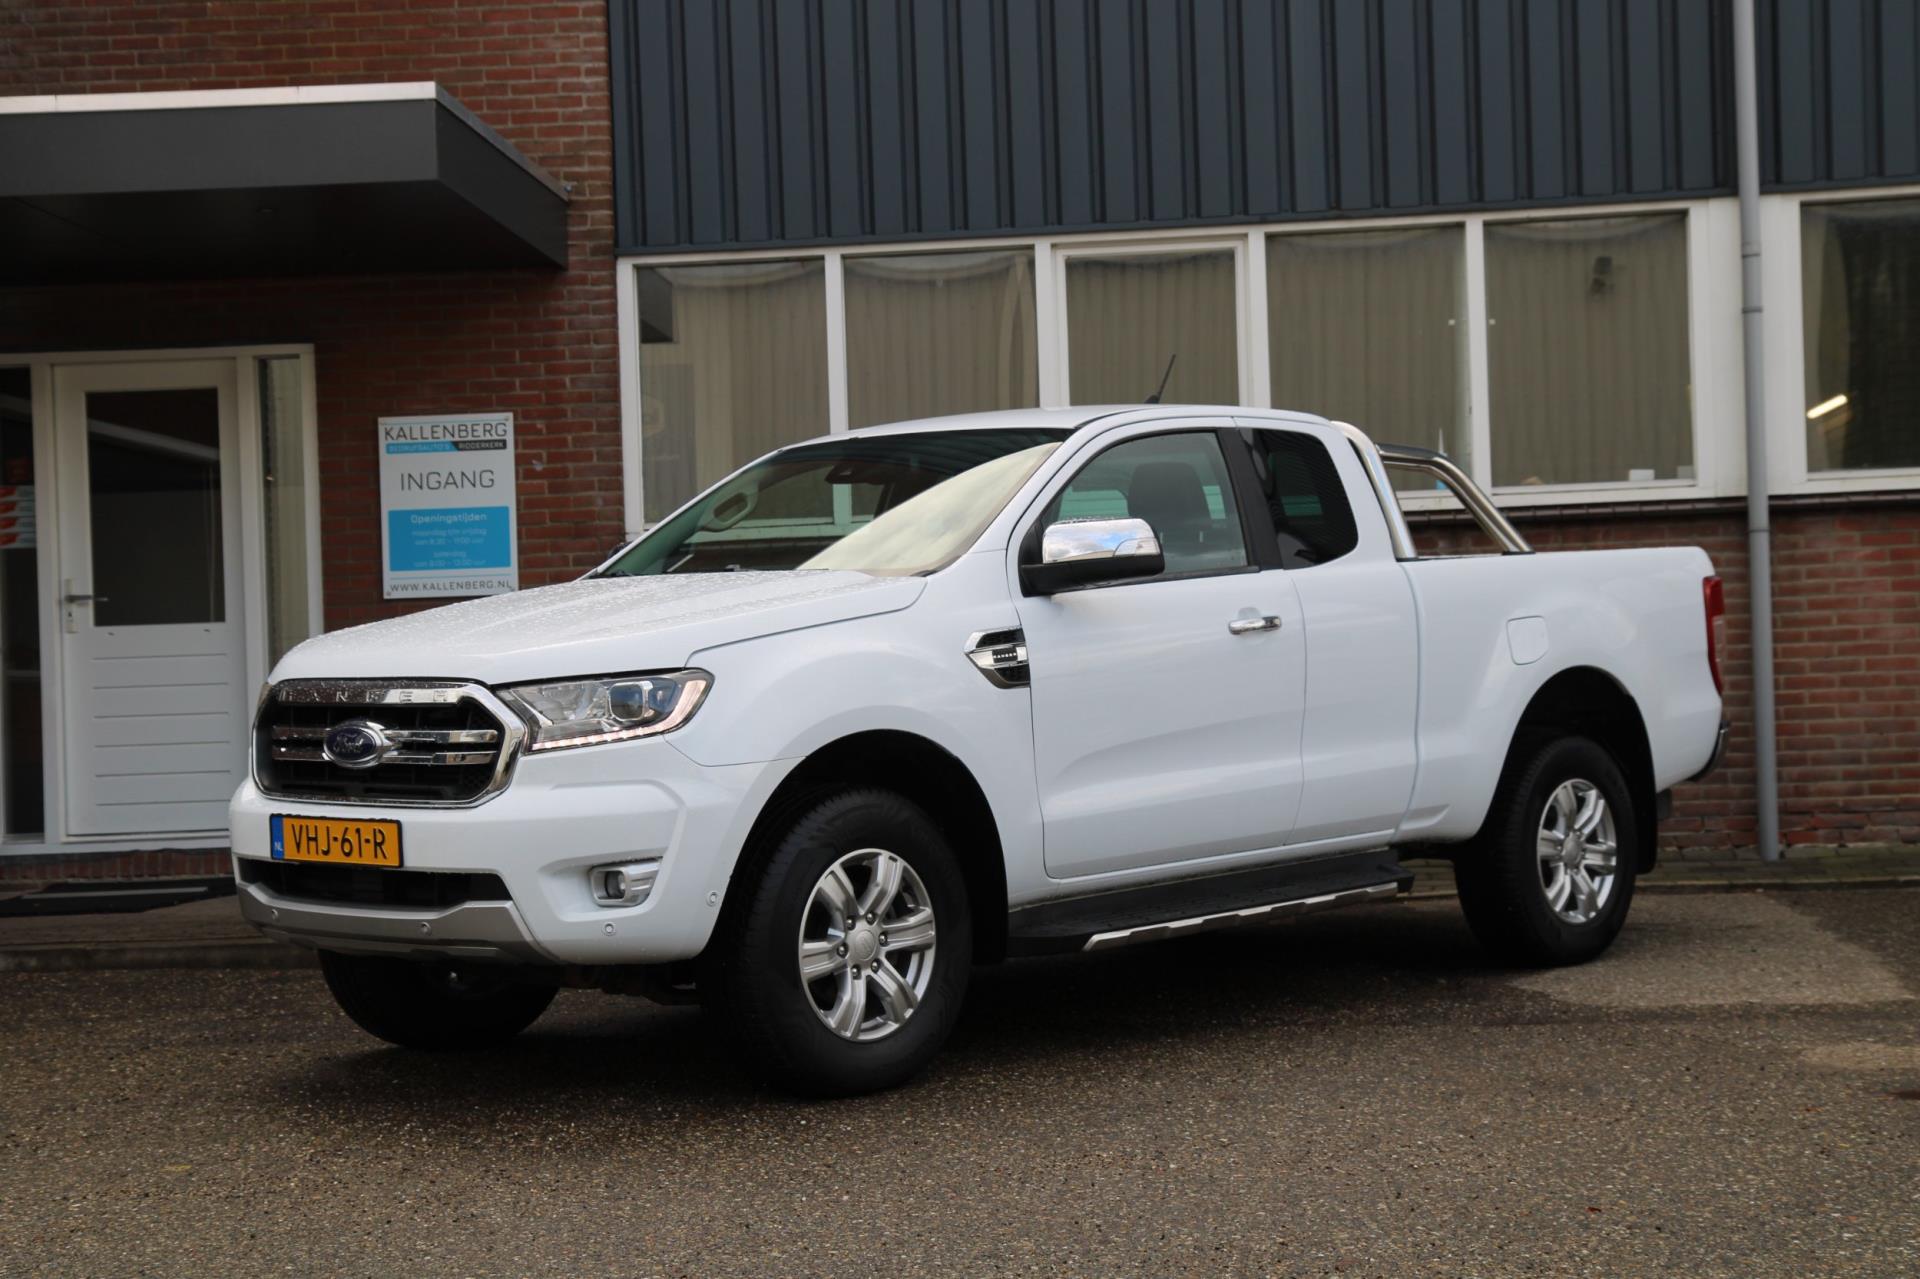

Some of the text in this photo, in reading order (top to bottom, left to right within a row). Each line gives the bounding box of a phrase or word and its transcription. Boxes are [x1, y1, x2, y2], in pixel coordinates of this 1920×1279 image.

[384, 422, 507, 441] KALLENBERG
[400, 469, 495, 491] INGANG
[410, 512, 487, 524] Openingstijden
[390, 580, 513, 592] WWW.KALLENBERG.NL
[291, 823, 387, 860] VHJ-61-R
